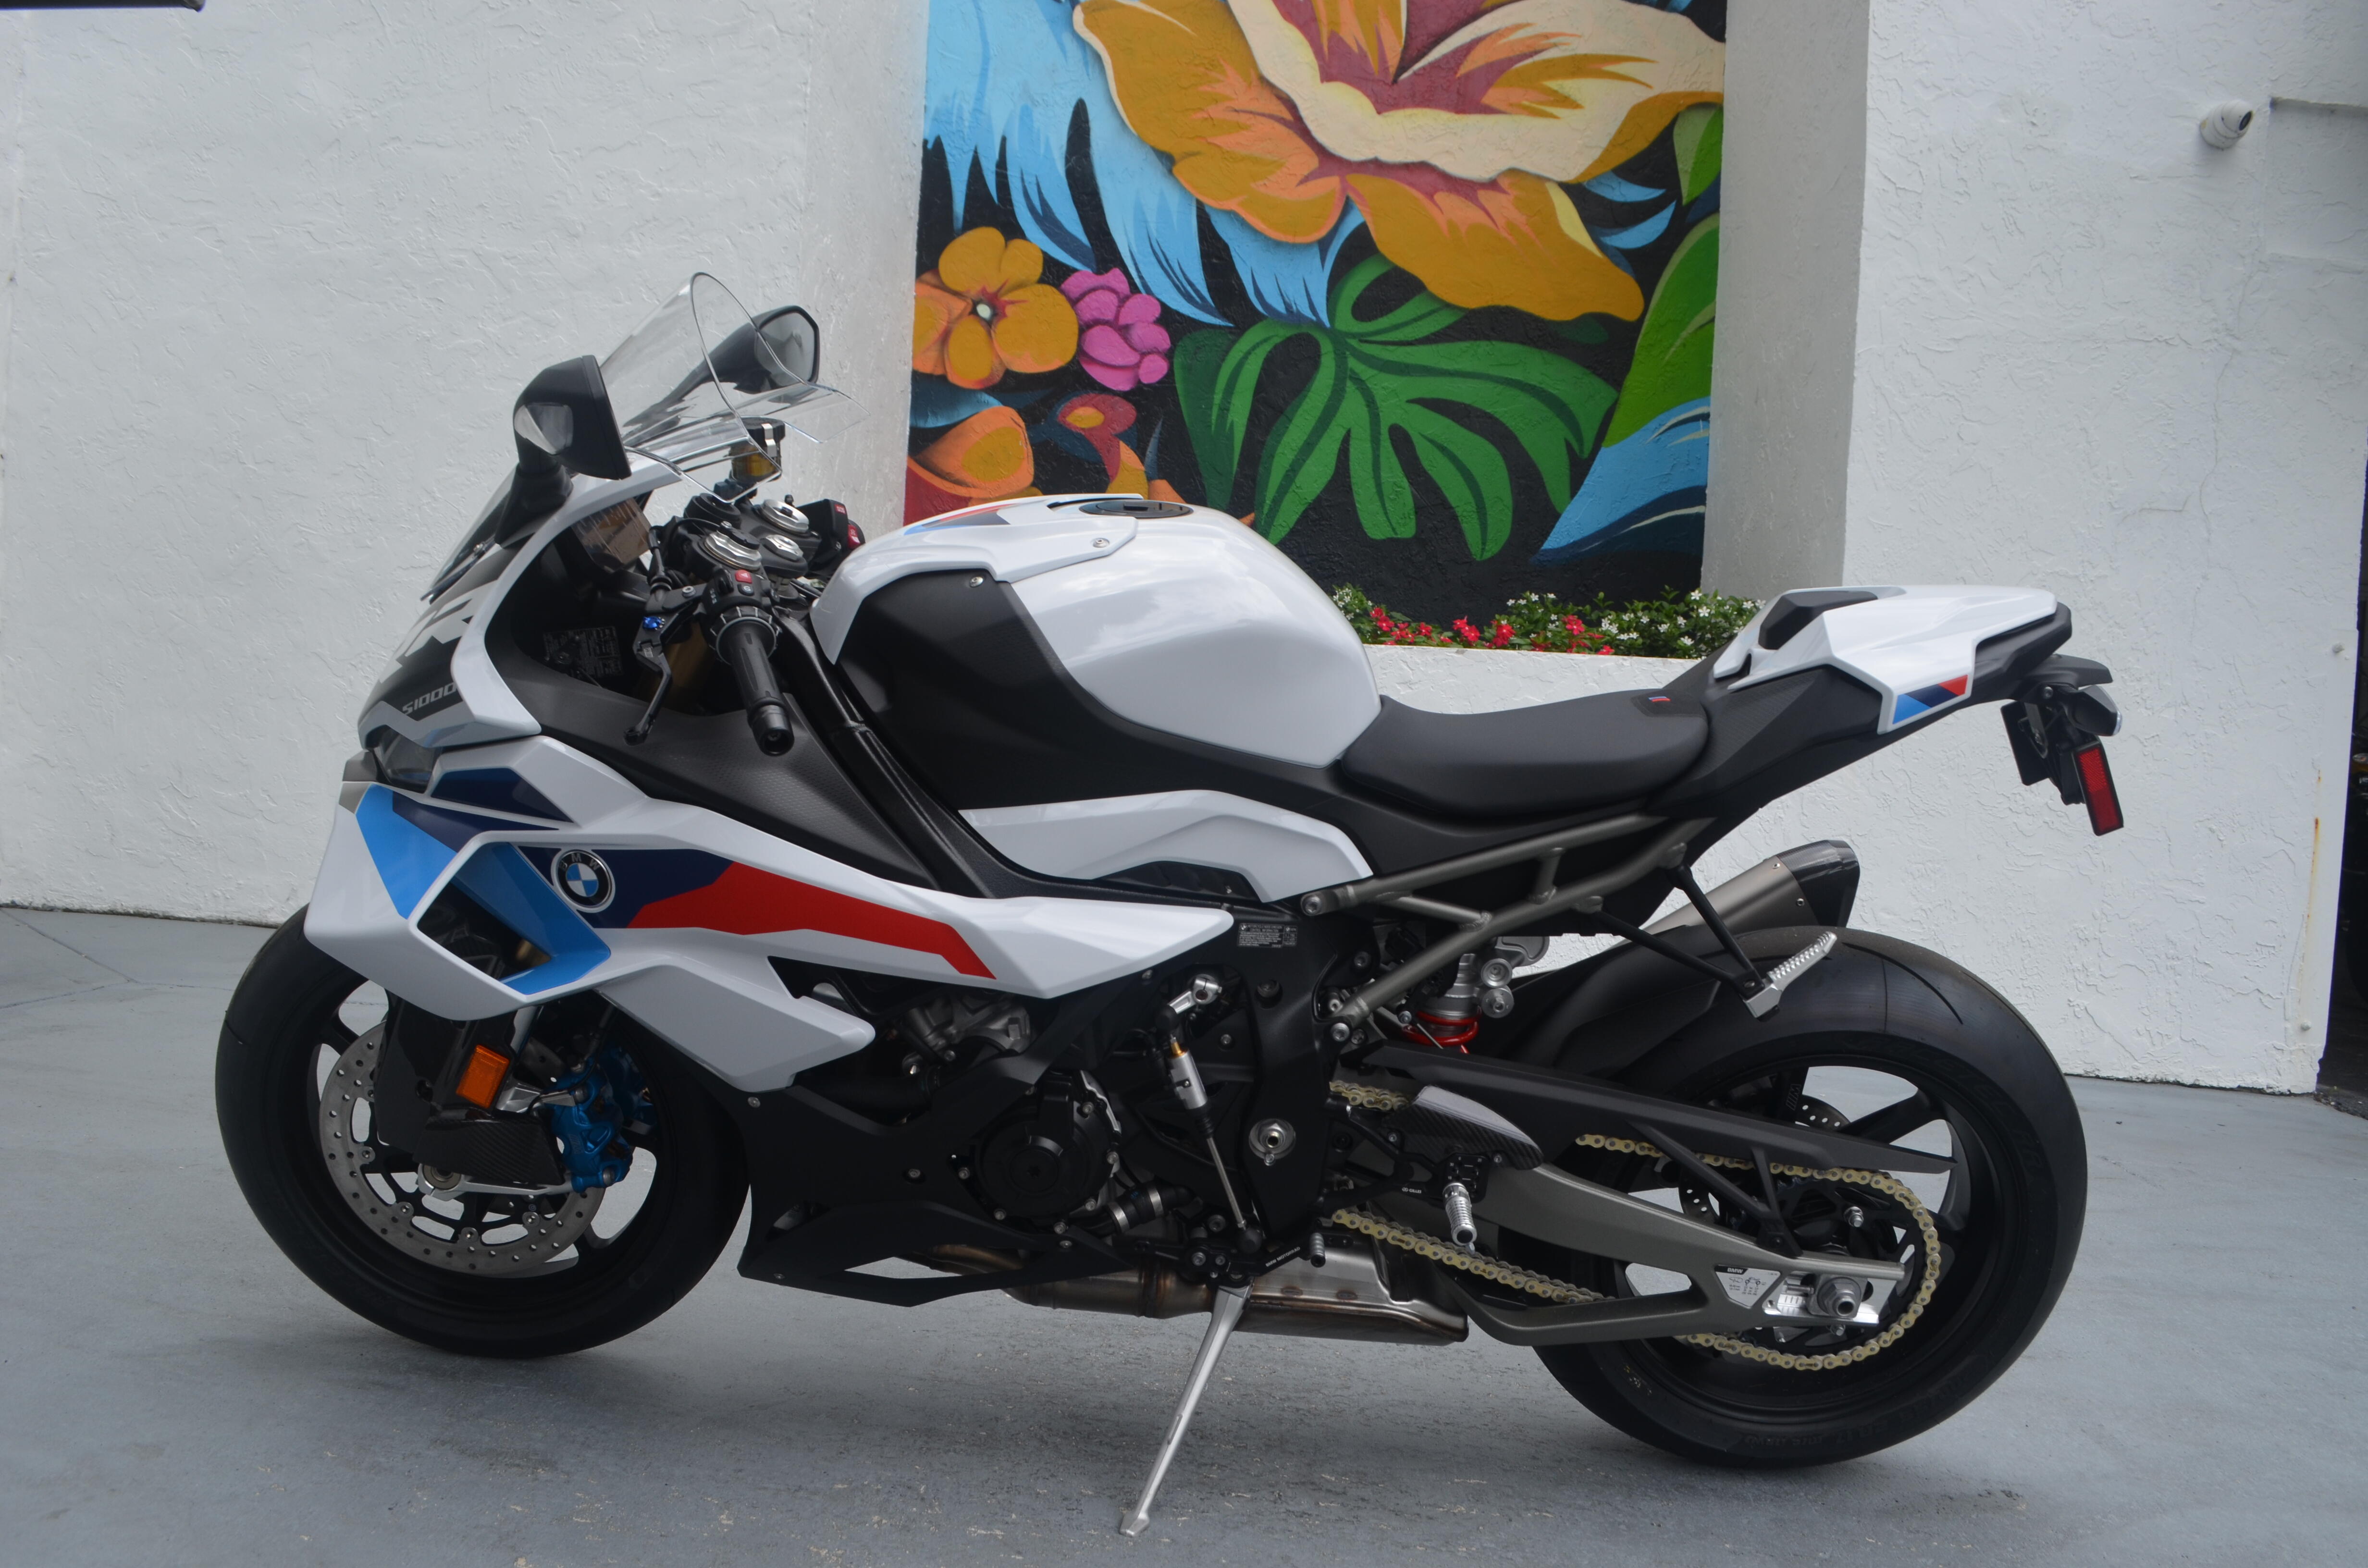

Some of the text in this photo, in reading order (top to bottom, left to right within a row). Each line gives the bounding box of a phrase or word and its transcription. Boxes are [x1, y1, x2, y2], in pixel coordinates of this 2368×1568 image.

[402, 682, 457, 715] S1000
[559, 853, 601, 871] BMW
[1265, 1246, 1301, 1267] BMW MOTORRAD
